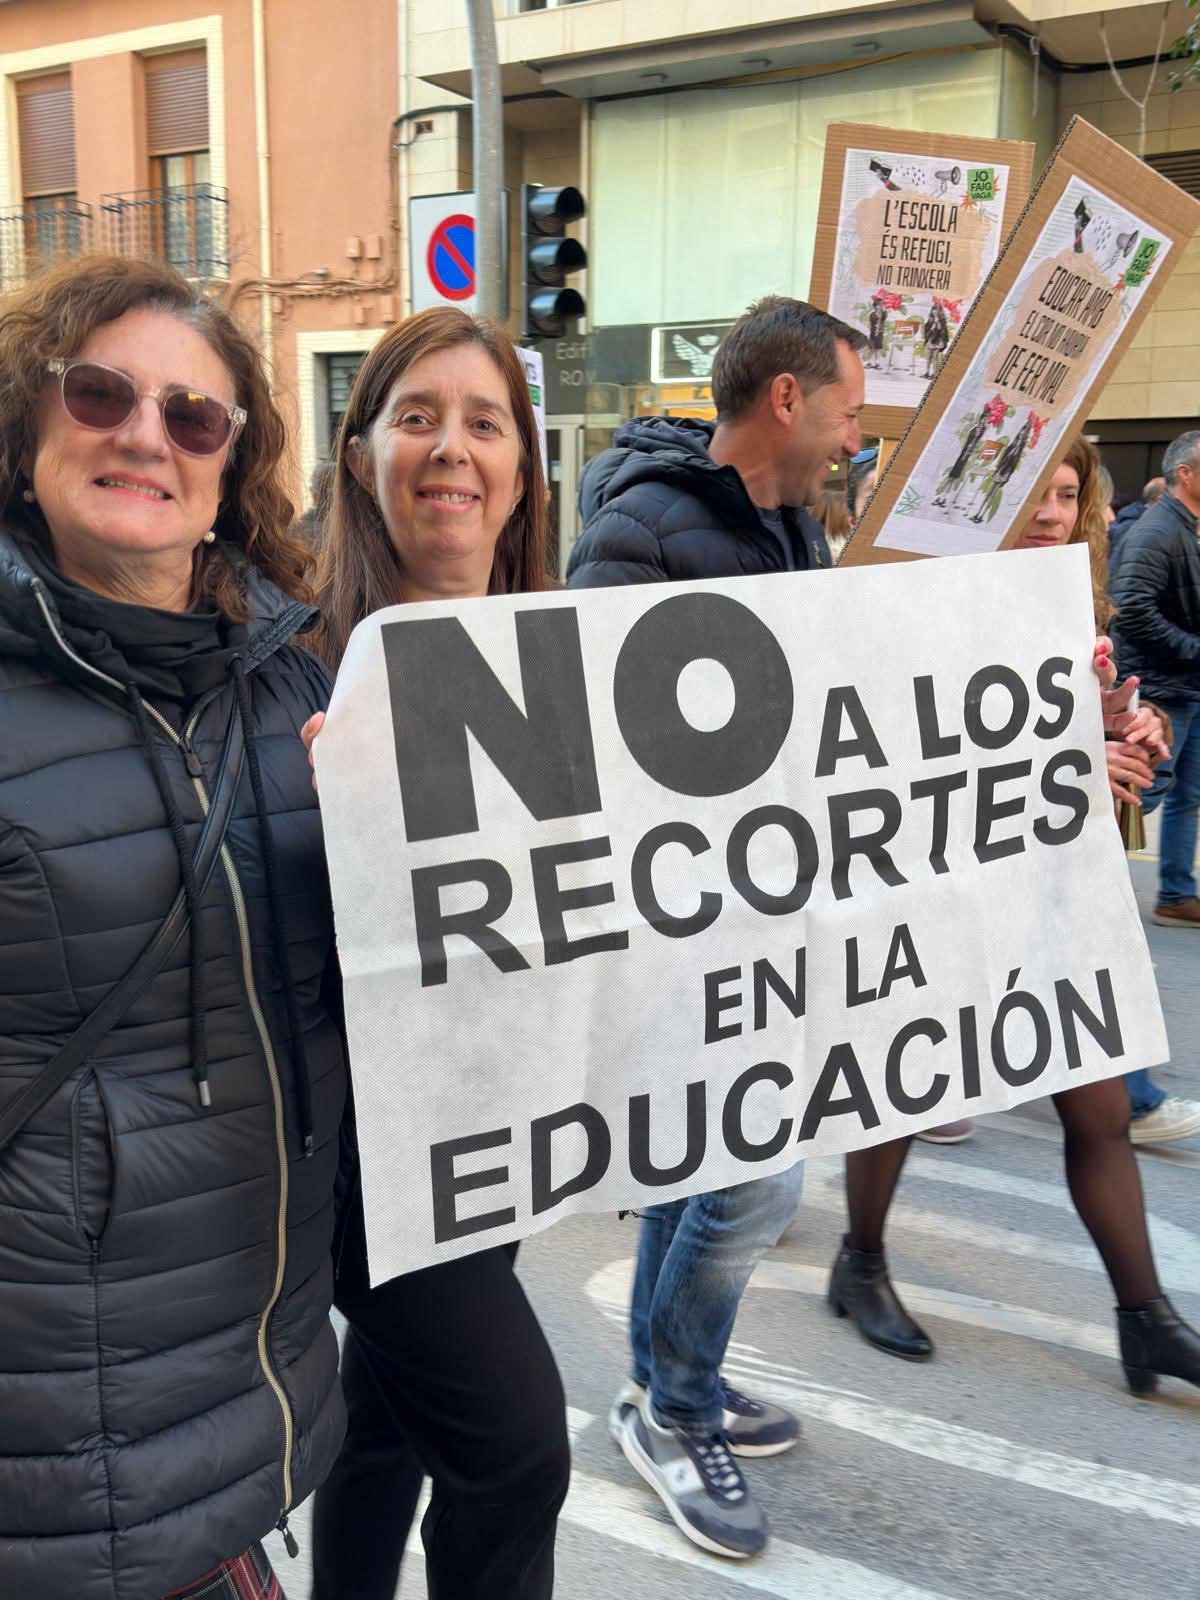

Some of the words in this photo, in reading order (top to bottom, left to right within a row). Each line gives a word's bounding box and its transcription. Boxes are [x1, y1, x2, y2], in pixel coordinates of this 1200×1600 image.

[971, 182, 992, 191] FAIG
[974, 170, 989, 182] JO
[883, 199, 958, 233] L'ESCOLA
[880, 229, 898, 259] ÉS
[901, 235, 952, 267] REFUGI,
[876, 264, 893, 285] NO
[897, 266, 951, 290] TRINXERA
[1038, 265, 1092, 320] EDUCAR
[1019, 310, 1039, 338] EL
[994, 344, 1027, 387] DE
[1012, 352, 1049, 396] FER
[381, 592, 794, 843] NO
[814, 685, 889, 778] A
[913, 656, 1075, 760] LOS
[410, 749, 1092, 988] RECORTES
[703, 946, 806, 1045] EN
[845, 923, 928, 1009] LA
[429, 967, 1125, 1245] EDUCACIÓN
